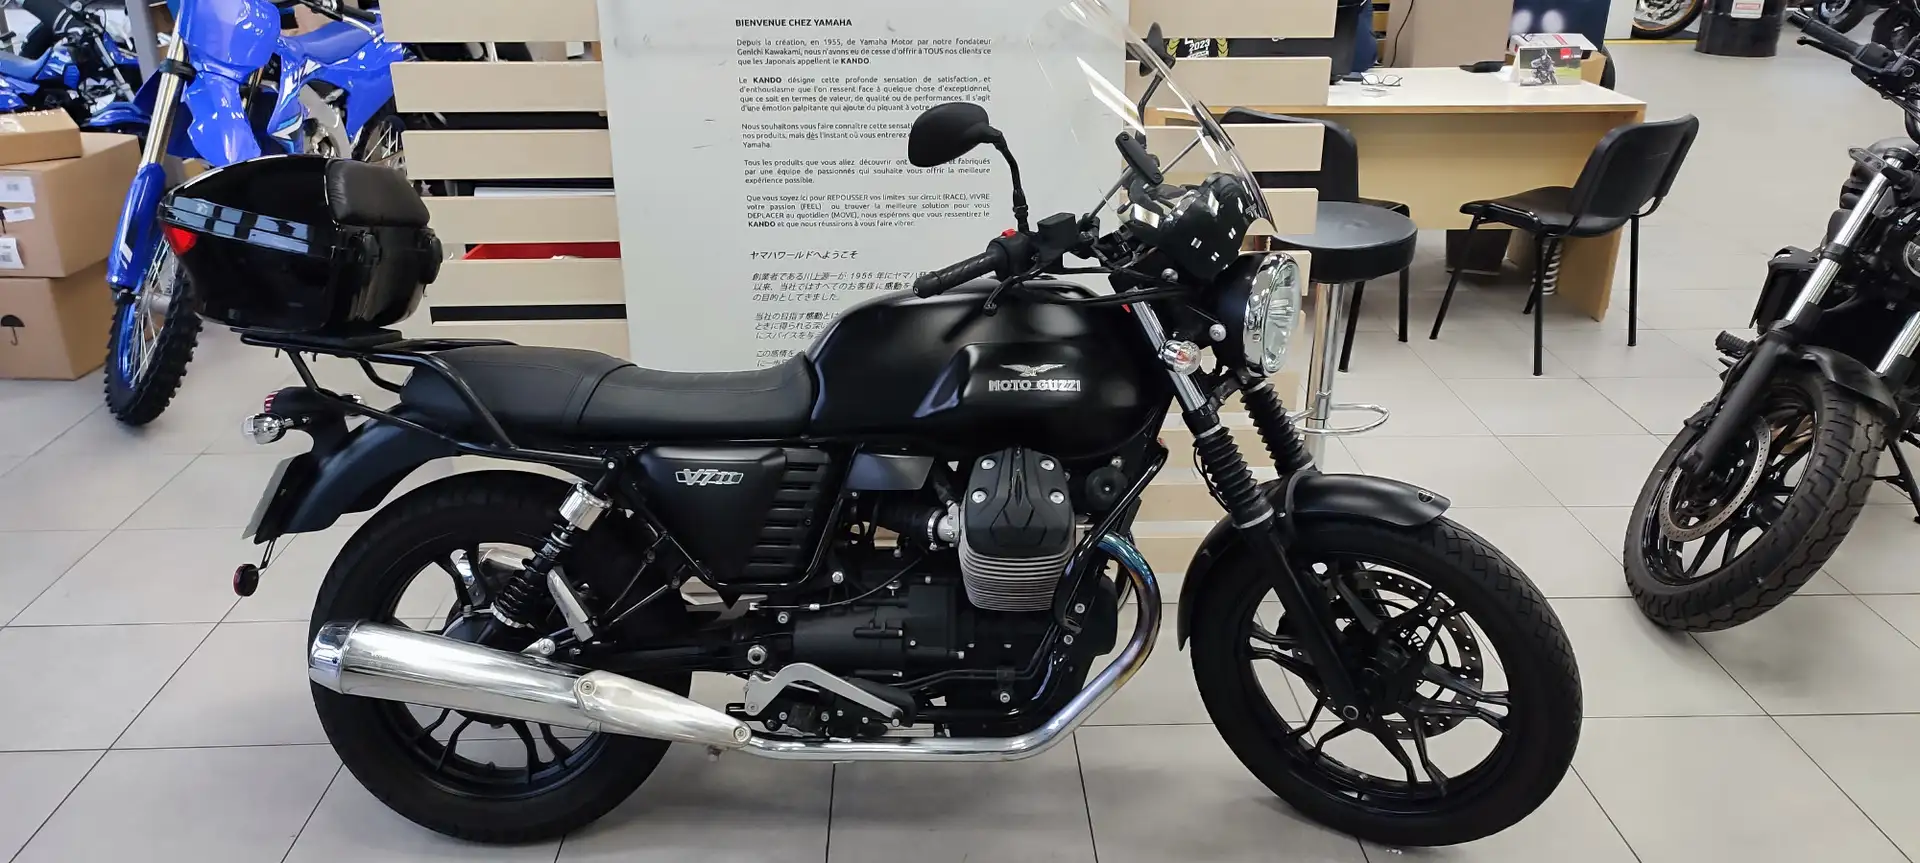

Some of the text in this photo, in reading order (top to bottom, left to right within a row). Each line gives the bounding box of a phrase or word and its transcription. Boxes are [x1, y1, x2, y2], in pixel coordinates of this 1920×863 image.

[736, 19, 787, 27] BIENVENUE
[814, 18, 852, 26] YAMAHA
[736, 39, 761, 47] Depuis
[846, 38, 856, 46] de
[1189, 39, 1210, 52] 2023
[959, 47, 982, 55] clients
[765, 58, 796, 66] Japonais
[797, 58, 831, 66] appellent
[788, 76, 816, 85] désigne
[845, 76, 878, 85] profonde
[829, 85, 856, 93] ressent
[884, 85, 912, 94] quelque
[829, 95, 853, 103] valeur,
[866, 95, 890, 103] qualité
[914, 95, 964, 103] performances.
[972, 94, 990, 103] s'agit
[793, 105, 829, 113] palpitante
[830, 104, 841, 113] qui
[843, 104, 865, 113] ajoute
[877, 104, 904, 113] piquant
[756, 132, 787, 140] produits,
[877, 131, 907, 139] entrerez
[774, 159, 804, 167] produits
[896, 158, 909, 166] ont
[958, 158, 990, 166] fabriqués
[777, 168, 801, 176] équipe
[818, 168, 855, 176] passionnés
[859, 167, 870, 176] qui
[745, 177, 814, 185] expérience possible.
[746, 194, 761, 203] Que
[883, 193, 905, 201] limites
[769, 203, 796, 211] passion
[800, 203, 822, 211] (FEEL)
[844, 202, 870, 210] trouver
[797, 211, 829, 220] quotidien
[879, 211, 910, 219] espérons
[750, 250, 858, 260] ヤマハワールドへようこそ
[850, 272, 873, 280] 1955
[989, 380, 1081, 391] MOTO GUZZI
